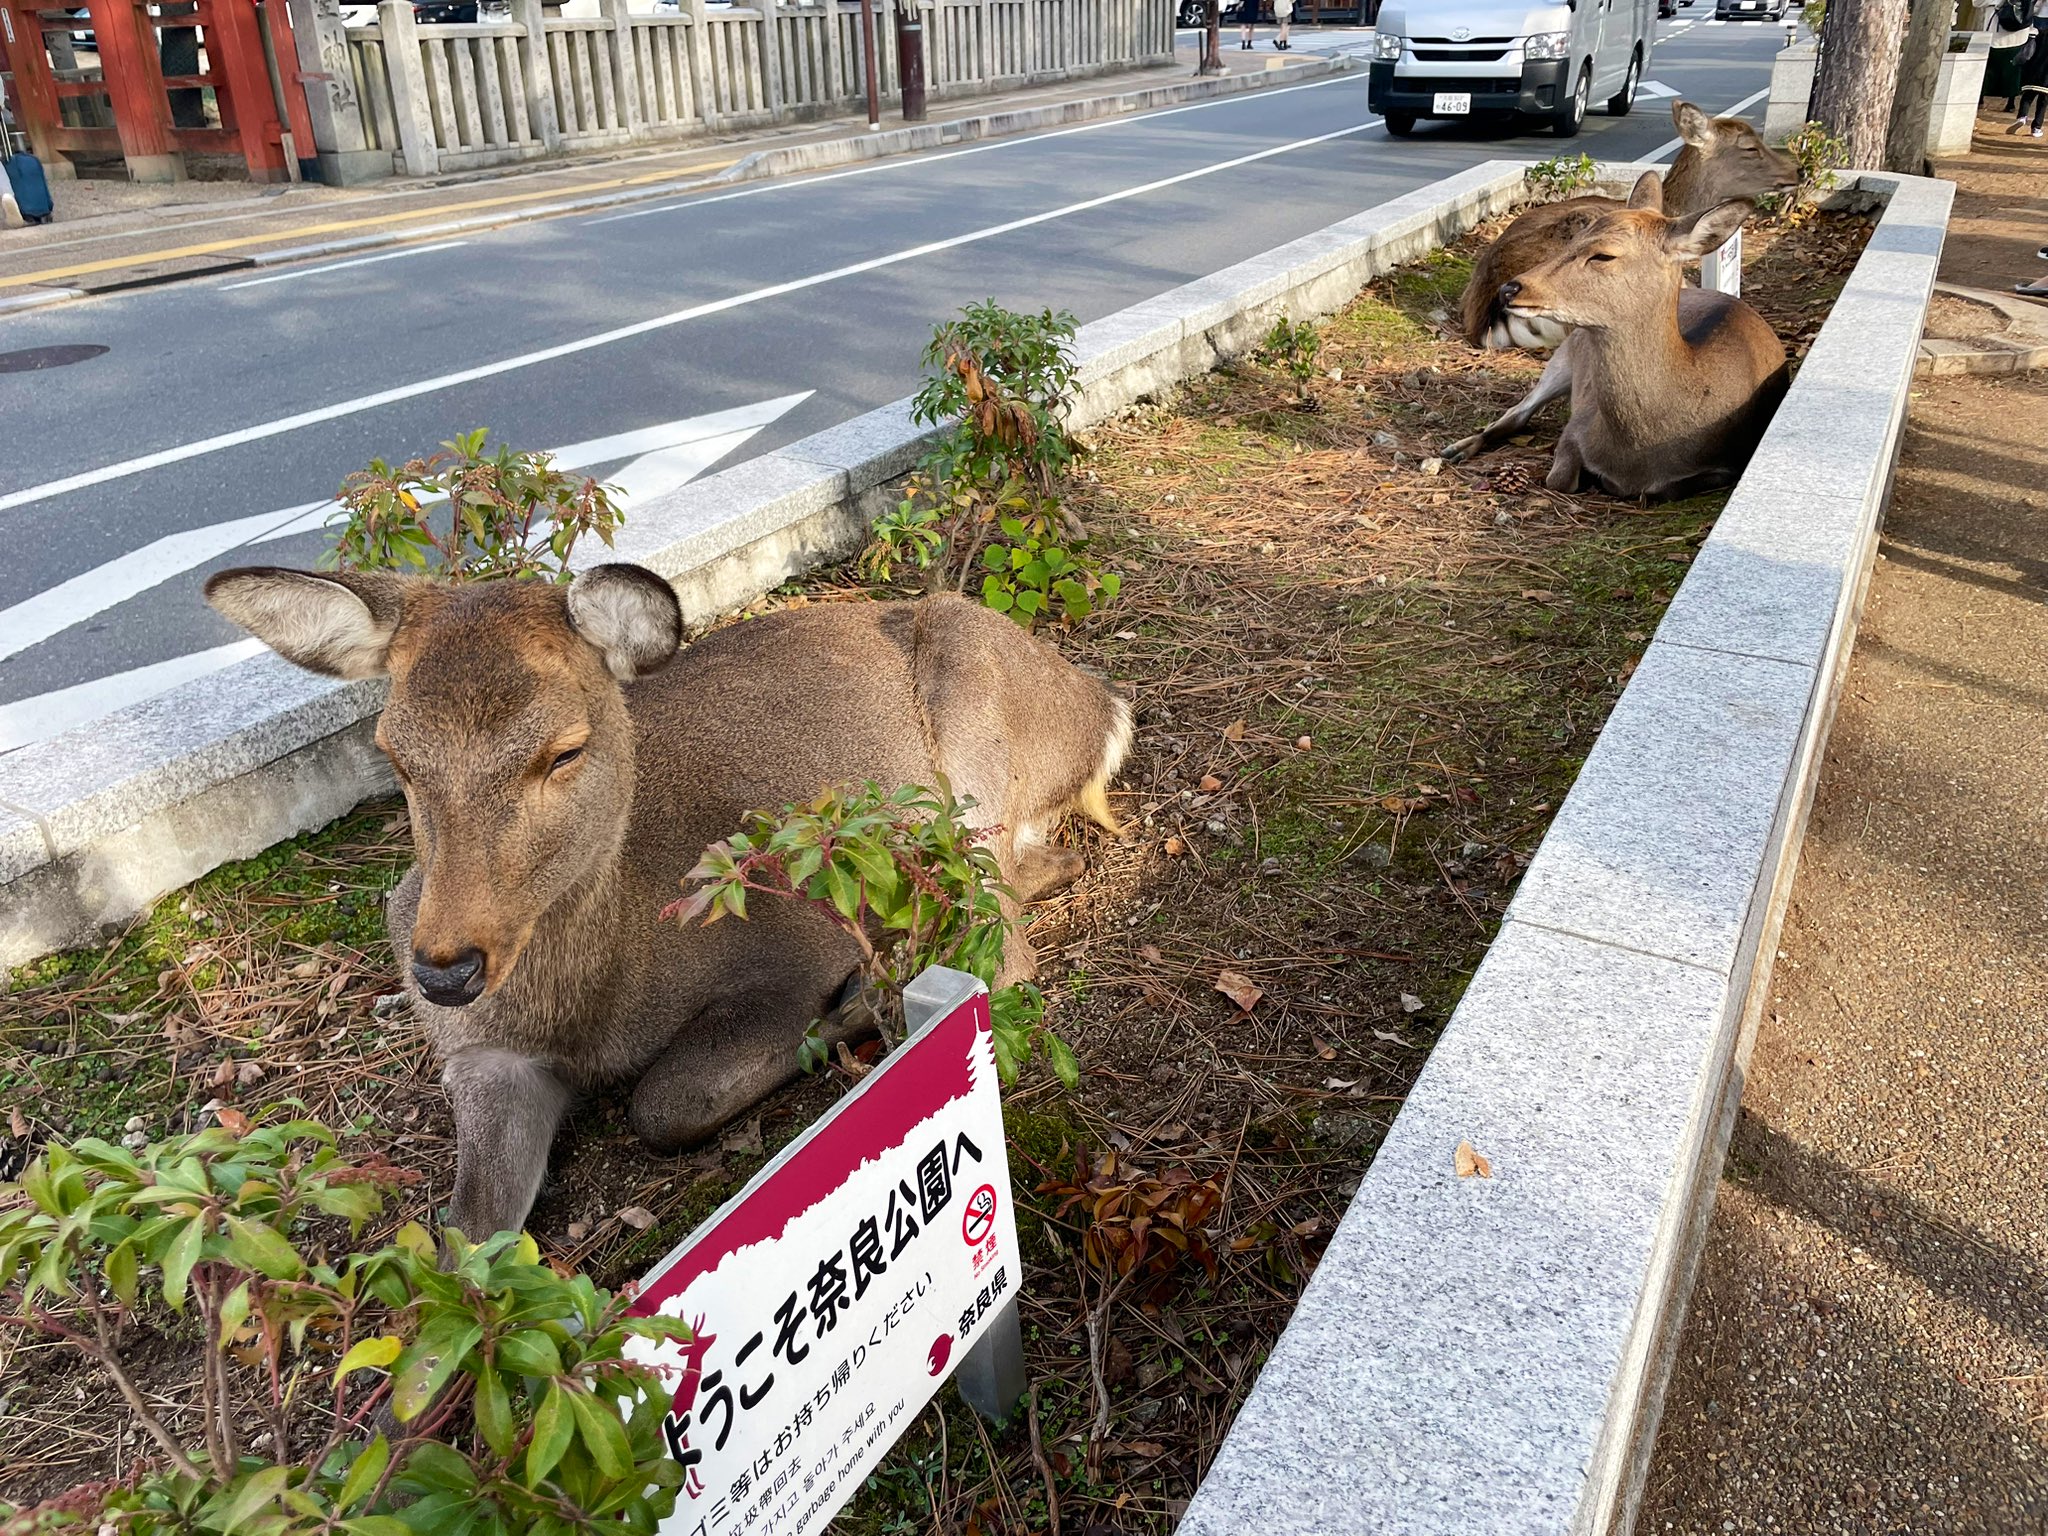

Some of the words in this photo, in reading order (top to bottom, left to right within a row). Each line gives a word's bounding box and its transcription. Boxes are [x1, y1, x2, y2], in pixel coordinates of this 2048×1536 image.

[661, 1131, 983, 1497] ようこそ奈良公園へ
[958, 1265, 1008, 1340] 奈良県
[972, 1231, 998, 1271] 禁煙
[760, 1490, 800, 1536] 가지고
[802, 1443, 839, 1493] 돌아가
[841, 1401, 877, 1445] 주세요
[795, 1480, 837, 1535] garbage
[837, 1446, 865, 1482] home
[866, 1420, 887, 1448] with
[887, 1397, 905, 1425] you
